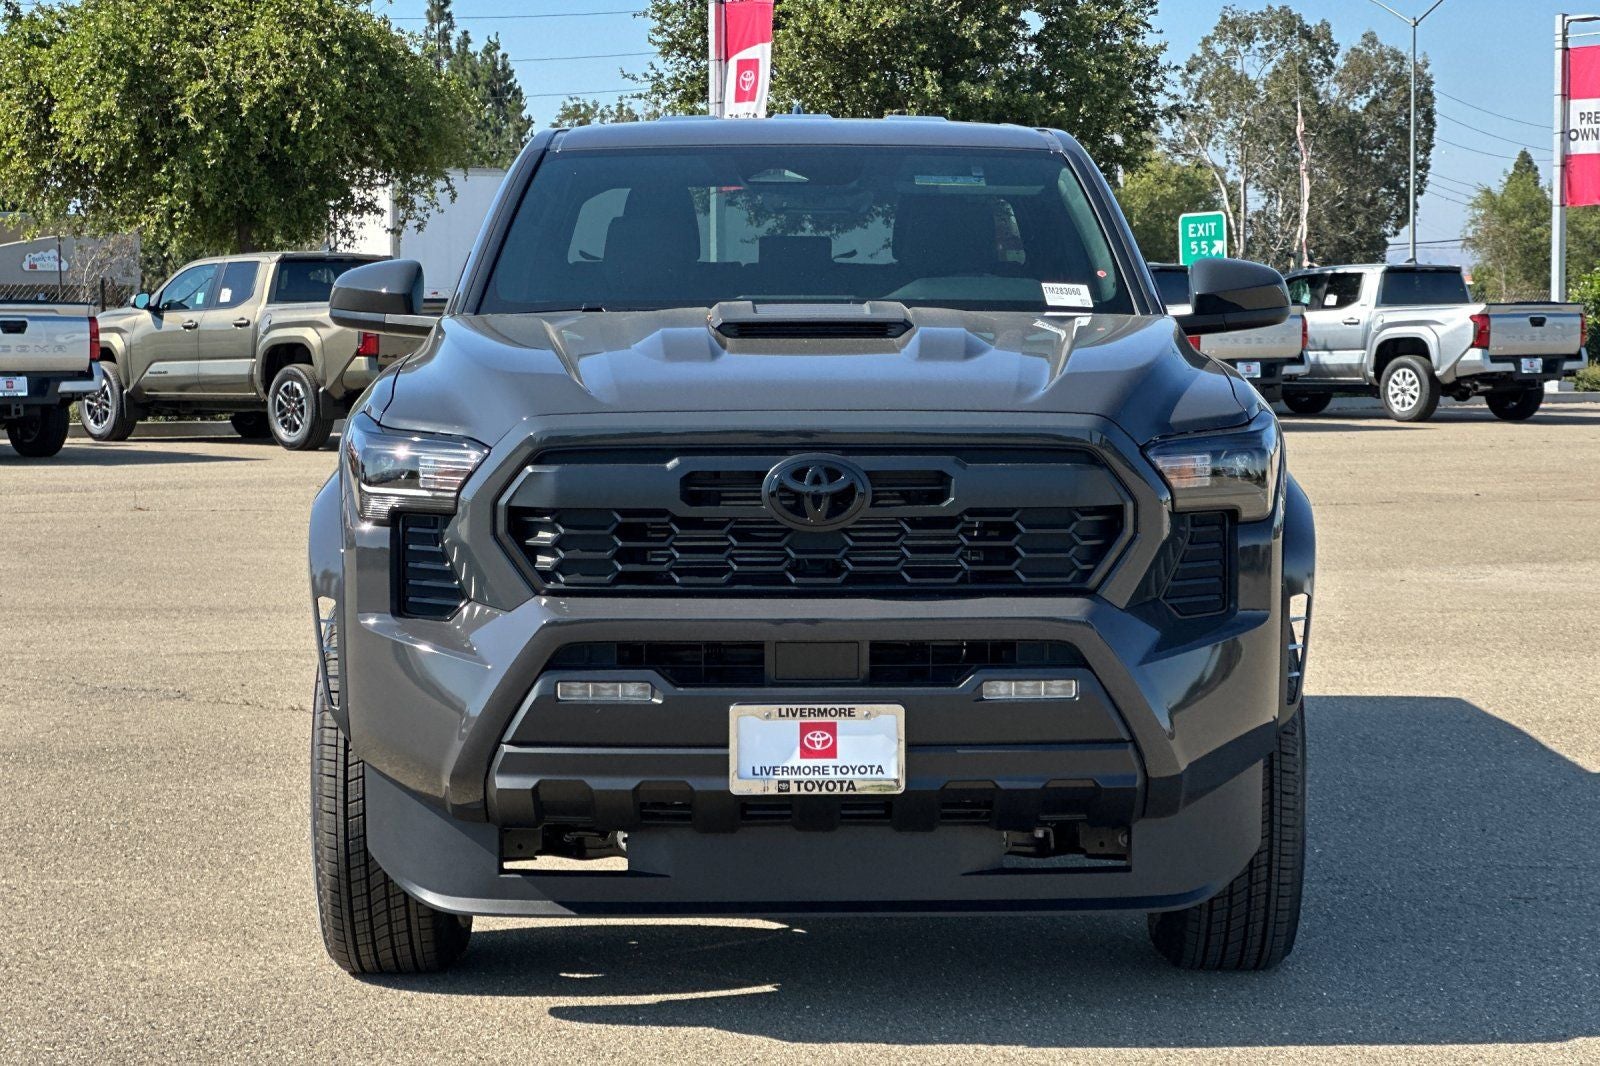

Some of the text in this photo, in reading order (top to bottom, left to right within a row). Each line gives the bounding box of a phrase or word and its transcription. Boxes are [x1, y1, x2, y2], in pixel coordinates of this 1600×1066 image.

[1579, 111, 1600, 125] PRE
[1188, 222, 1217, 238] EXIT
[1044, 286, 1082, 296] TM283060
[778, 707, 856, 718] LIVERMORE
[752, 764, 885, 777] LIVERMORE TOYOTA
[794, 780, 857, 793] TOYOTA
